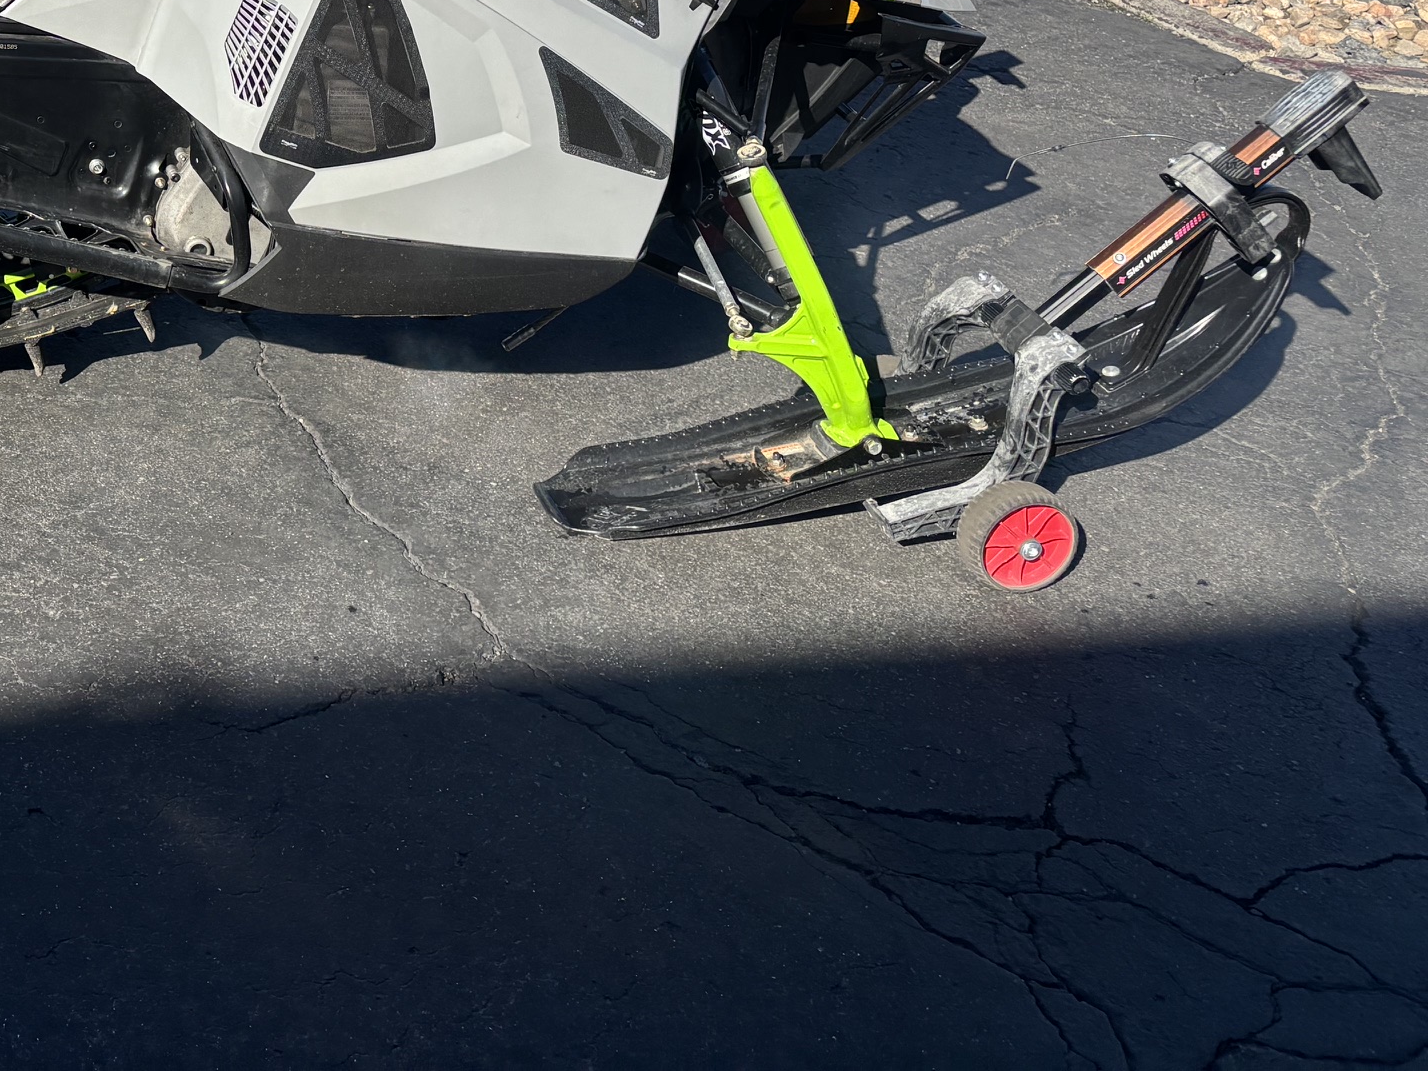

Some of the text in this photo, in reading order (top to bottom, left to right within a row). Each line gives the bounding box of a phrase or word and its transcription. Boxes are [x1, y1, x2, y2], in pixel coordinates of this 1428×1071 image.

[1261, 147, 1285, 170] Caliber
[1126, 236, 1174, 279] Sled Wheels
